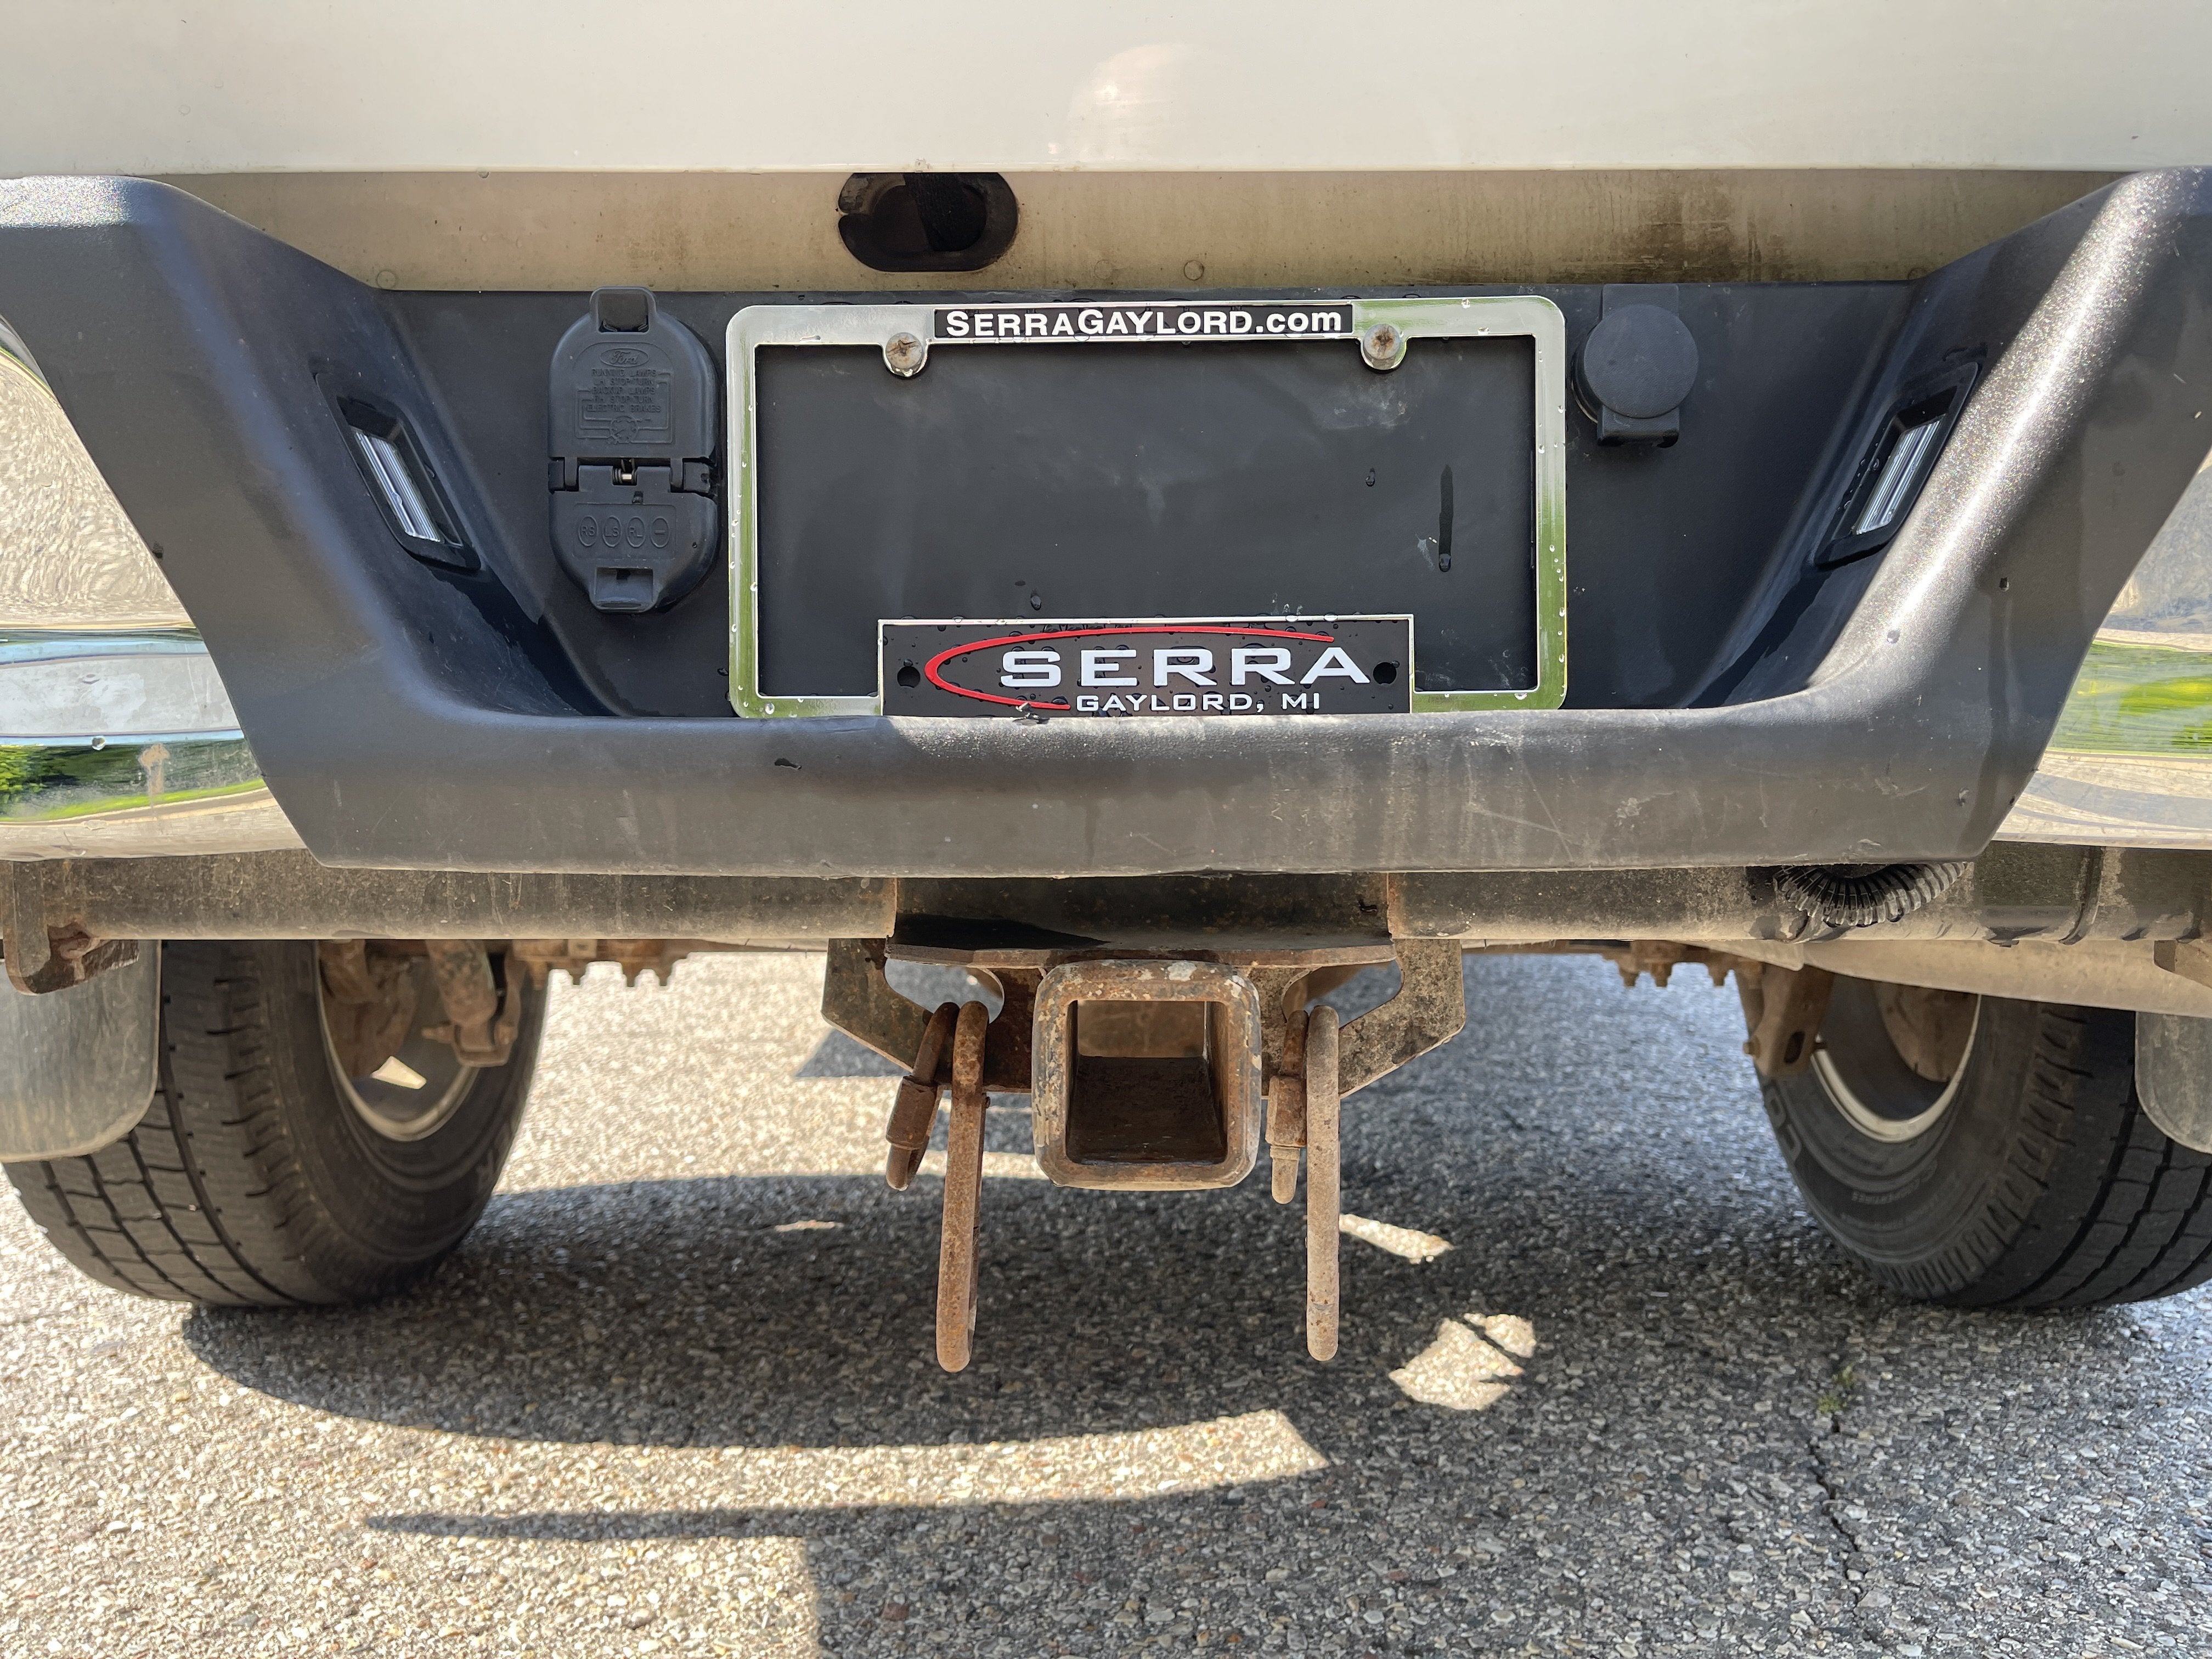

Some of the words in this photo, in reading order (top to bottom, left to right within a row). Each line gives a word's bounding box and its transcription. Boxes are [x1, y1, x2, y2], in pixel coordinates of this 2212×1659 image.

[946, 309, 1341, 336] SERRAGAYLORD.com
[610, 351, 640, 365] Ford
[630, 405, 661, 413] BRAKES
[581, 526, 596, 537] RS
[605, 526, 620, 537] LS
[629, 527, 644, 538] RL
[1000, 647, 1370, 687] SERRA
[1076, 694, 1264, 713] GAYLORD,
[1282, 693, 1319, 709] MI
